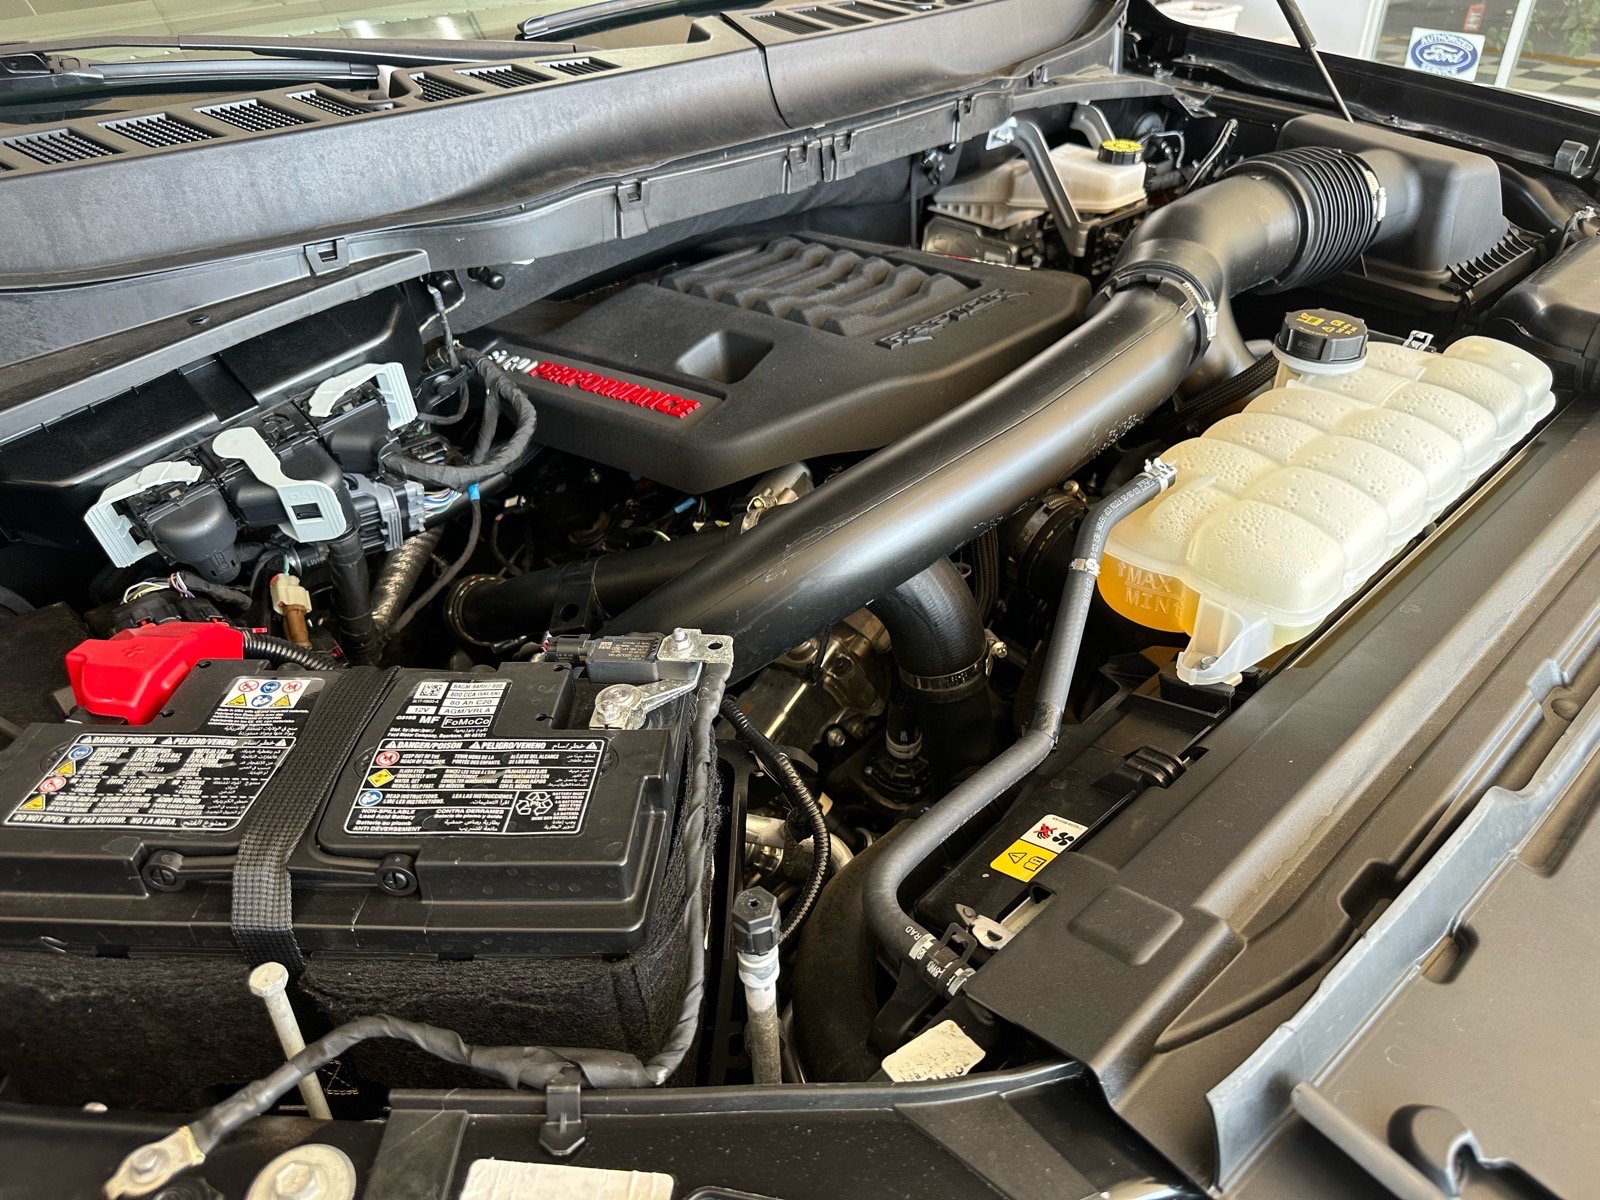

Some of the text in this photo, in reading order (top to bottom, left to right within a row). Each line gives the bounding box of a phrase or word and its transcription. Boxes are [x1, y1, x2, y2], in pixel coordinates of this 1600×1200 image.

[1423, 46, 1465, 63] Ford
[529, 361, 701, 420] PERFORMANCE
[1126, 565, 1172, 593] MAX
[1125, 587, 1170, 614] MIN
[419, 716, 441, 724] MF
[172, 738, 238, 746] PELIGRO/VENENO
[396, 741, 463, 749] DANGER/POISON
[14, 814, 177, 826] DO NOT OPEN. NE PAS OUVRIR. NO LA ABRA.
[905, 926, 922, 941] RAD
